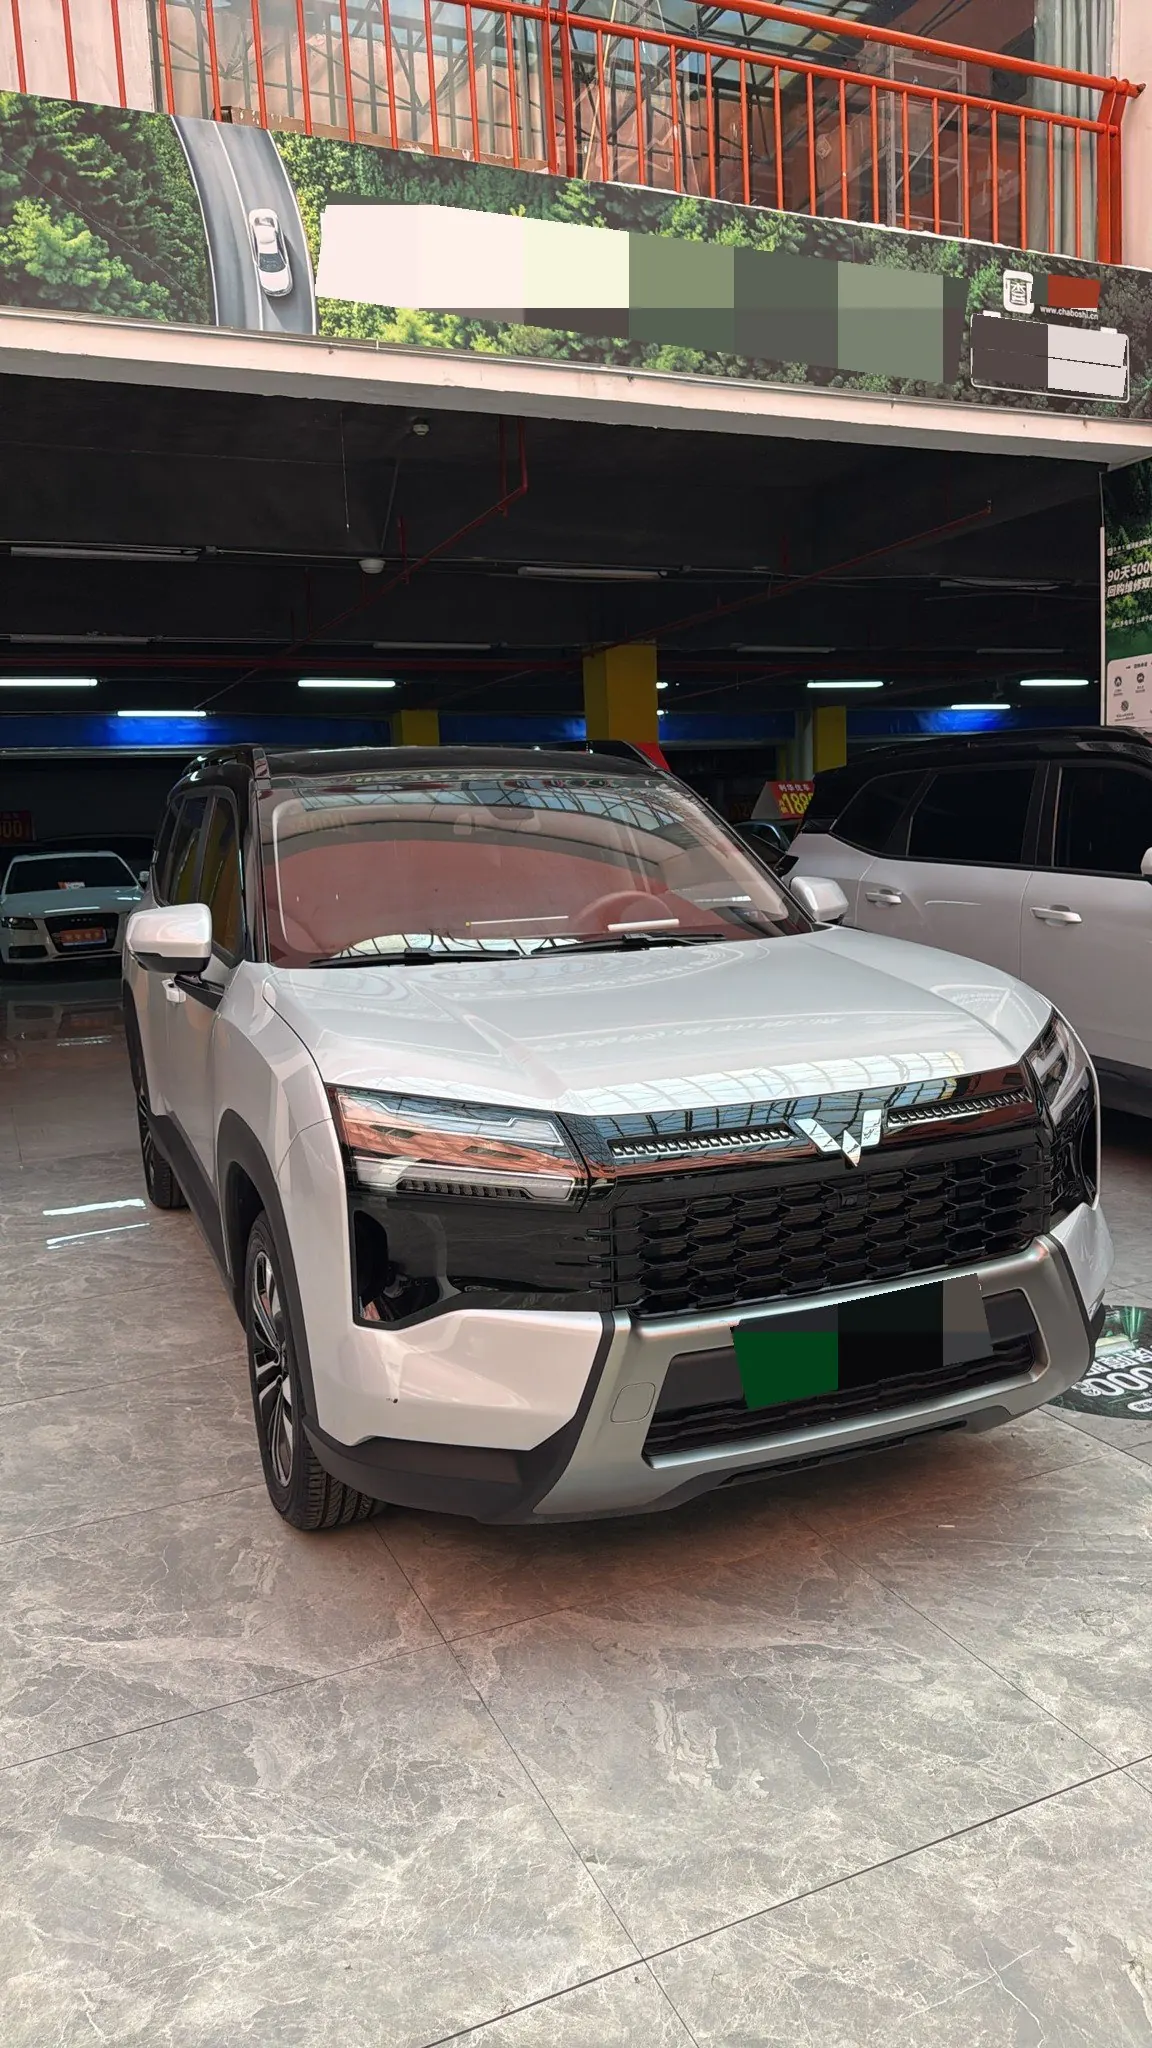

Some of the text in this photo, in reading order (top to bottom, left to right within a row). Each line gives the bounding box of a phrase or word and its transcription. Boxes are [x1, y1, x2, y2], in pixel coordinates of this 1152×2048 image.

[1039, 305, 1099, 320] www.chaboshi.cn
[1107, 577, 1152, 597] 回购维修双
